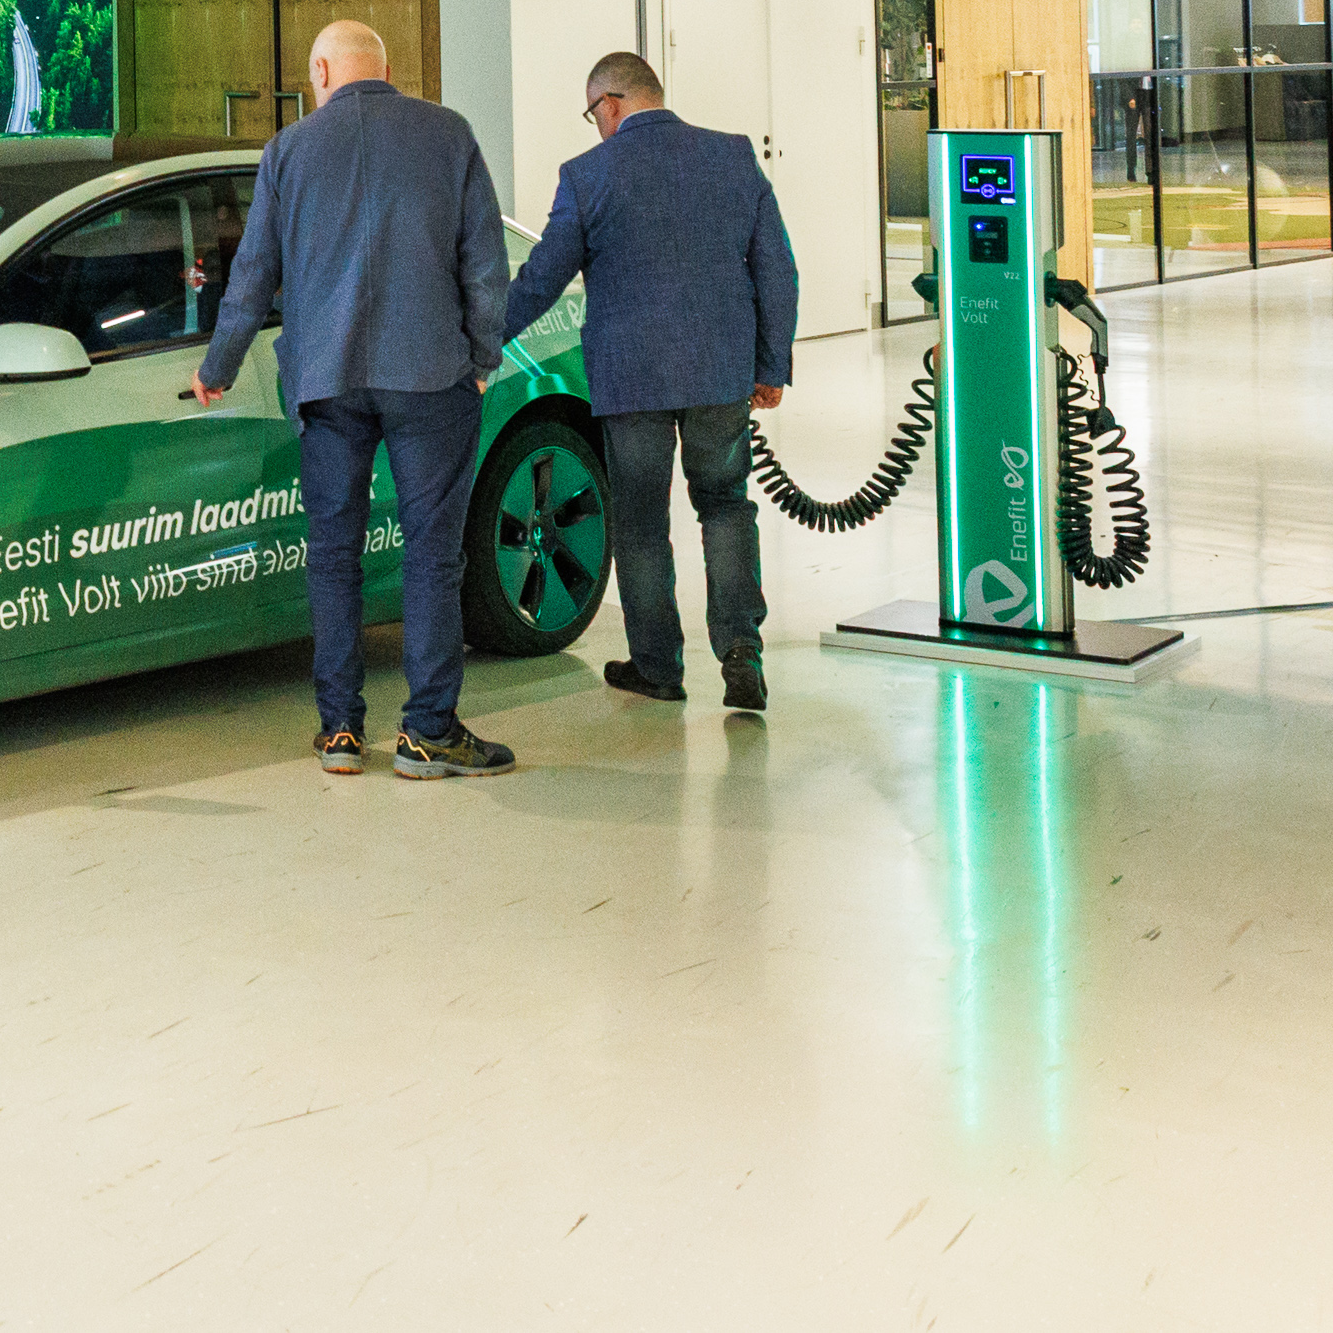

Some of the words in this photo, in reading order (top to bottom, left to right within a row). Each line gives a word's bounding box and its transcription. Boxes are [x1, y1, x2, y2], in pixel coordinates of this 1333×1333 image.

[1003, 271, 1021, 280] V22
[960, 296, 999, 310] Enefit
[960, 311, 988, 324] Volt
[517, 308, 570, 340] nefit
[69, 506, 184, 559] suurim
[1008, 496, 1028, 562] Enefit
[58, 574, 122, 617] Volt
[131, 563, 188, 604] viib
[196, 546, 258, 592] sind
